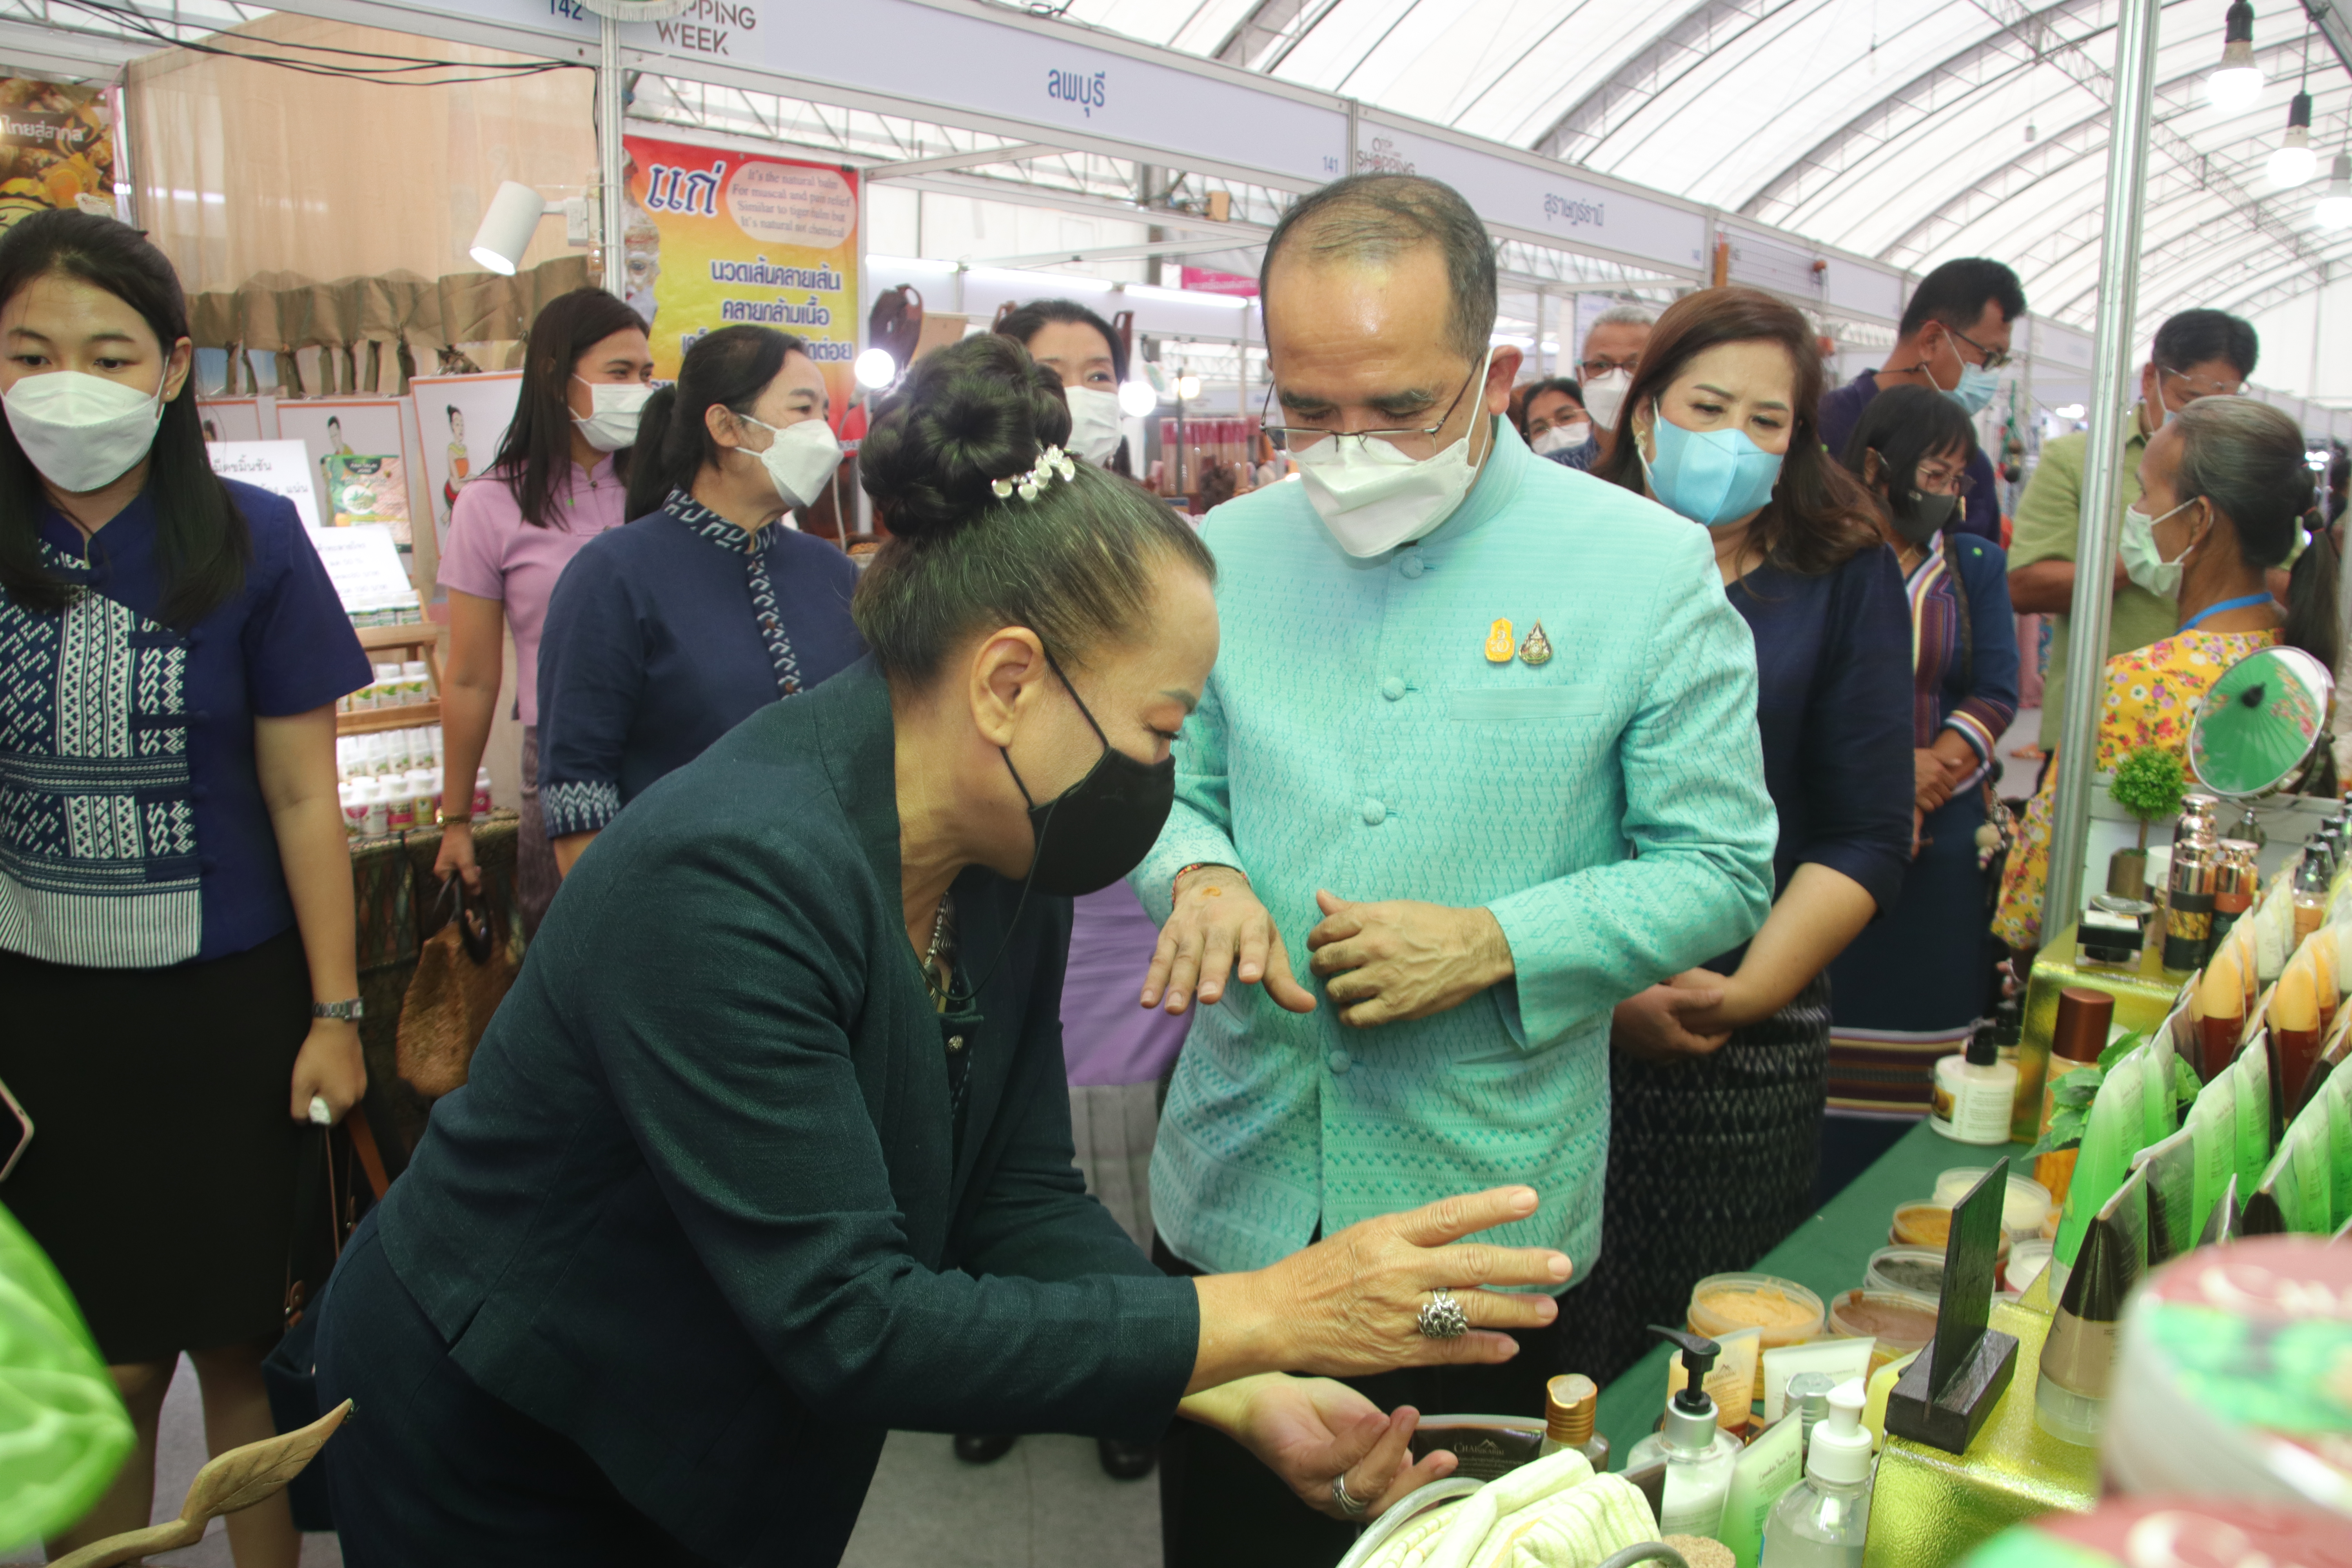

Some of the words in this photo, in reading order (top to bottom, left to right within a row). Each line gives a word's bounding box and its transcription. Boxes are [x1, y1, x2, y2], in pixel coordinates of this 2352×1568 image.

[656, 20, 728, 55] WEEK
[1049, 68, 1105, 118] ลพบุรี
[1323, 156, 1338, 173] 141
[648, 163, 723, 214] แก่
[732, 183, 748, 196] For
[789, 190, 807, 201] and
[737, 200, 774, 212] Similar
[711, 256, 841, 290] นวดเส้นคลายเส้น
[722, 296, 829, 326] คลายกล้ามเนื้อ
